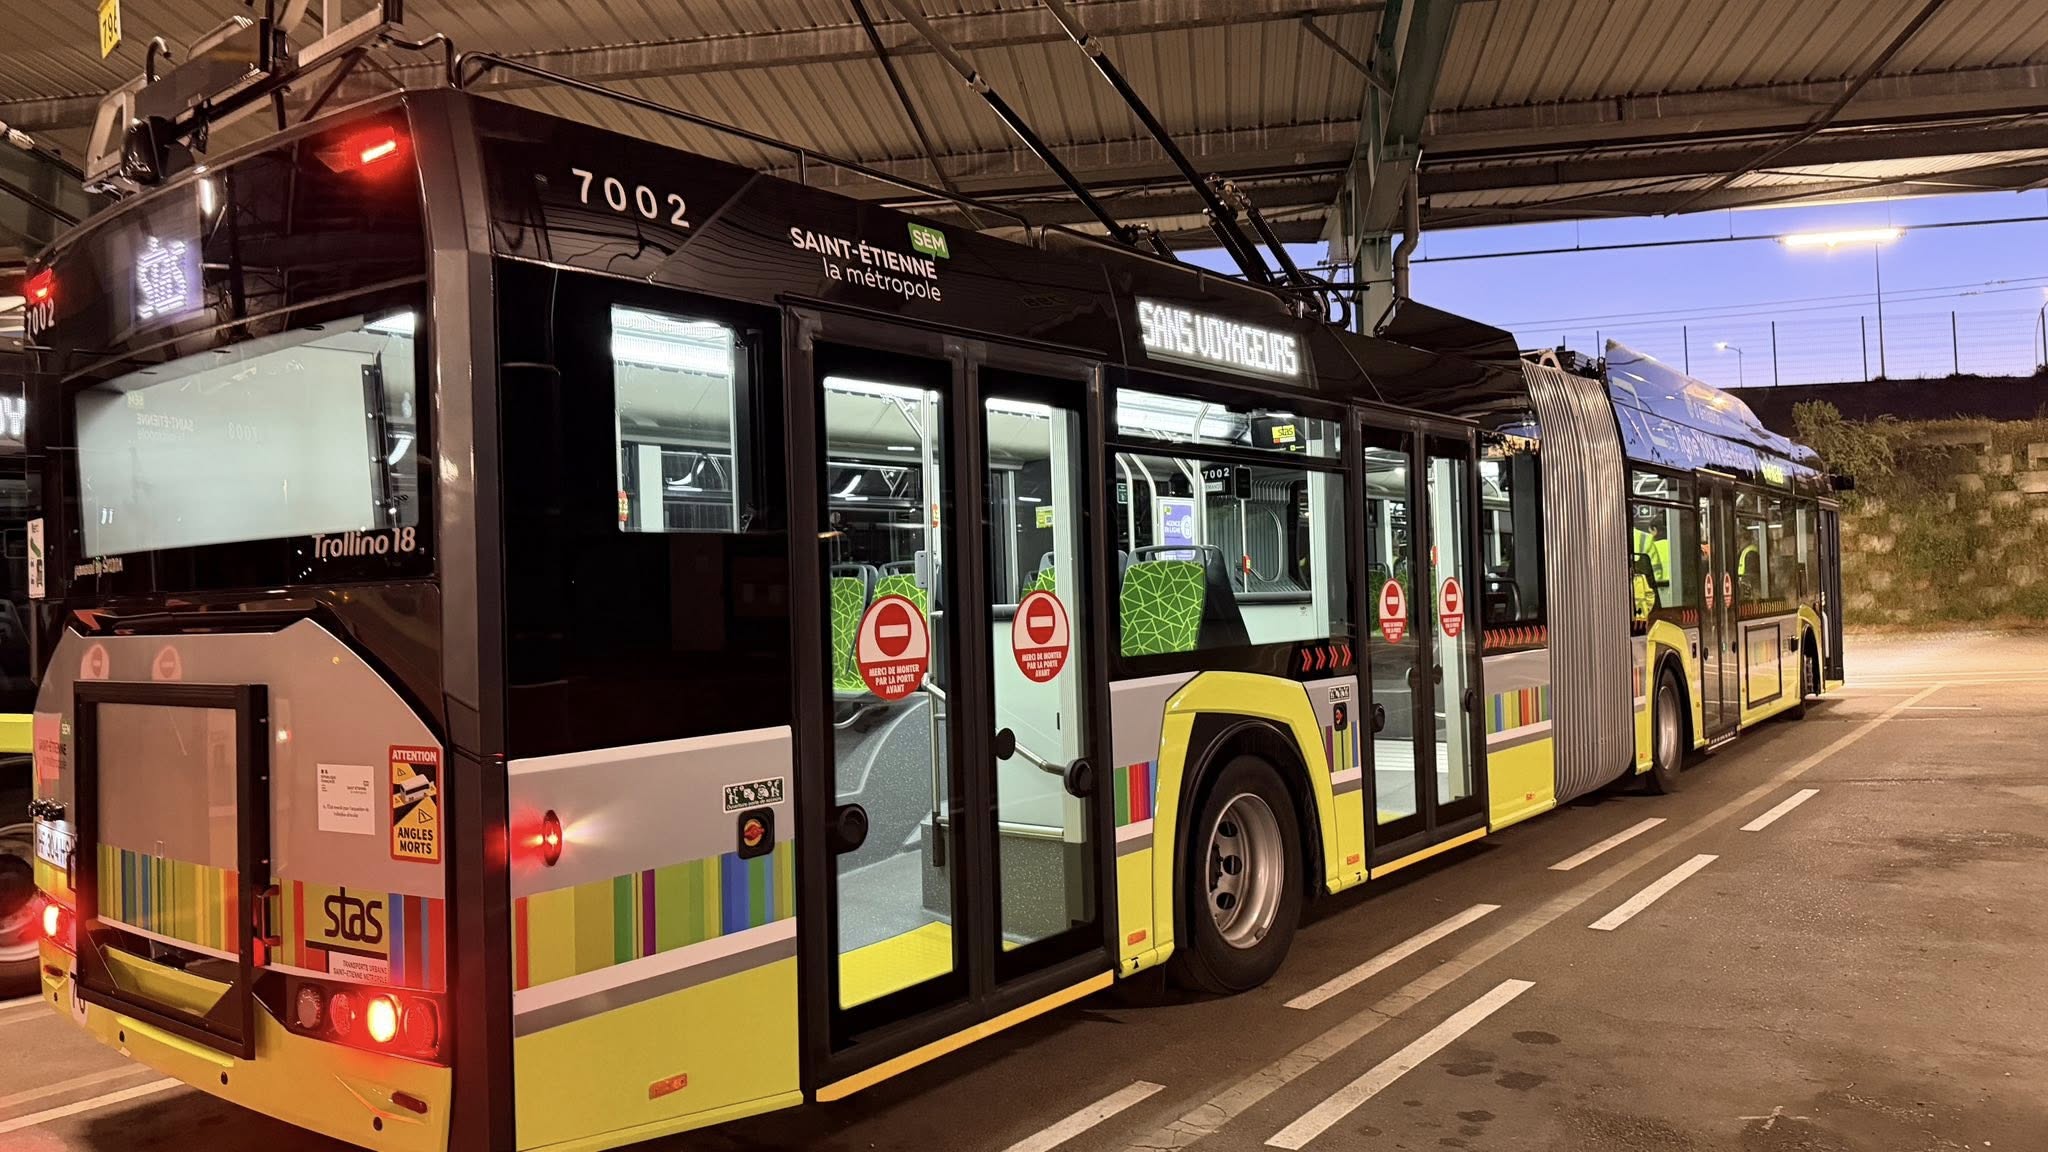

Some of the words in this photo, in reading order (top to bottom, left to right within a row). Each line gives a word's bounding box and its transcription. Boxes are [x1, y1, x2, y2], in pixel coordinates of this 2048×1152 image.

[571, 167, 690, 228] 7002
[912, 228, 946, 252] SÉM
[790, 226, 938, 280] SAINT-ÉTIENNE
[823, 257, 842, 281] la
[846, 266, 941, 301] métropole
[1139, 301, 1194, 354] SANS
[1194, 314, 1298, 376] VOYAGEURS
[1202, 467, 1230, 480] 7002
[312, 531, 389, 558] Trollino
[392, 526, 416, 553] 18
[869, 667, 887, 677] MERCI
[888, 666, 896, 675] DE
[896, 664, 920, 674] MONTER
[1036, 661, 1043, 669] LA
[875, 677, 887, 686] PAR
[888, 676, 896, 685] LA
[896, 674, 914, 683] PORTE
[886, 684, 905, 694] AVANT
[392, 749, 437, 762] ATTENTION
[398, 827, 434, 841] ANGLES
[400, 840, 432, 855] MORTS
[324, 886, 383, 945] stas
